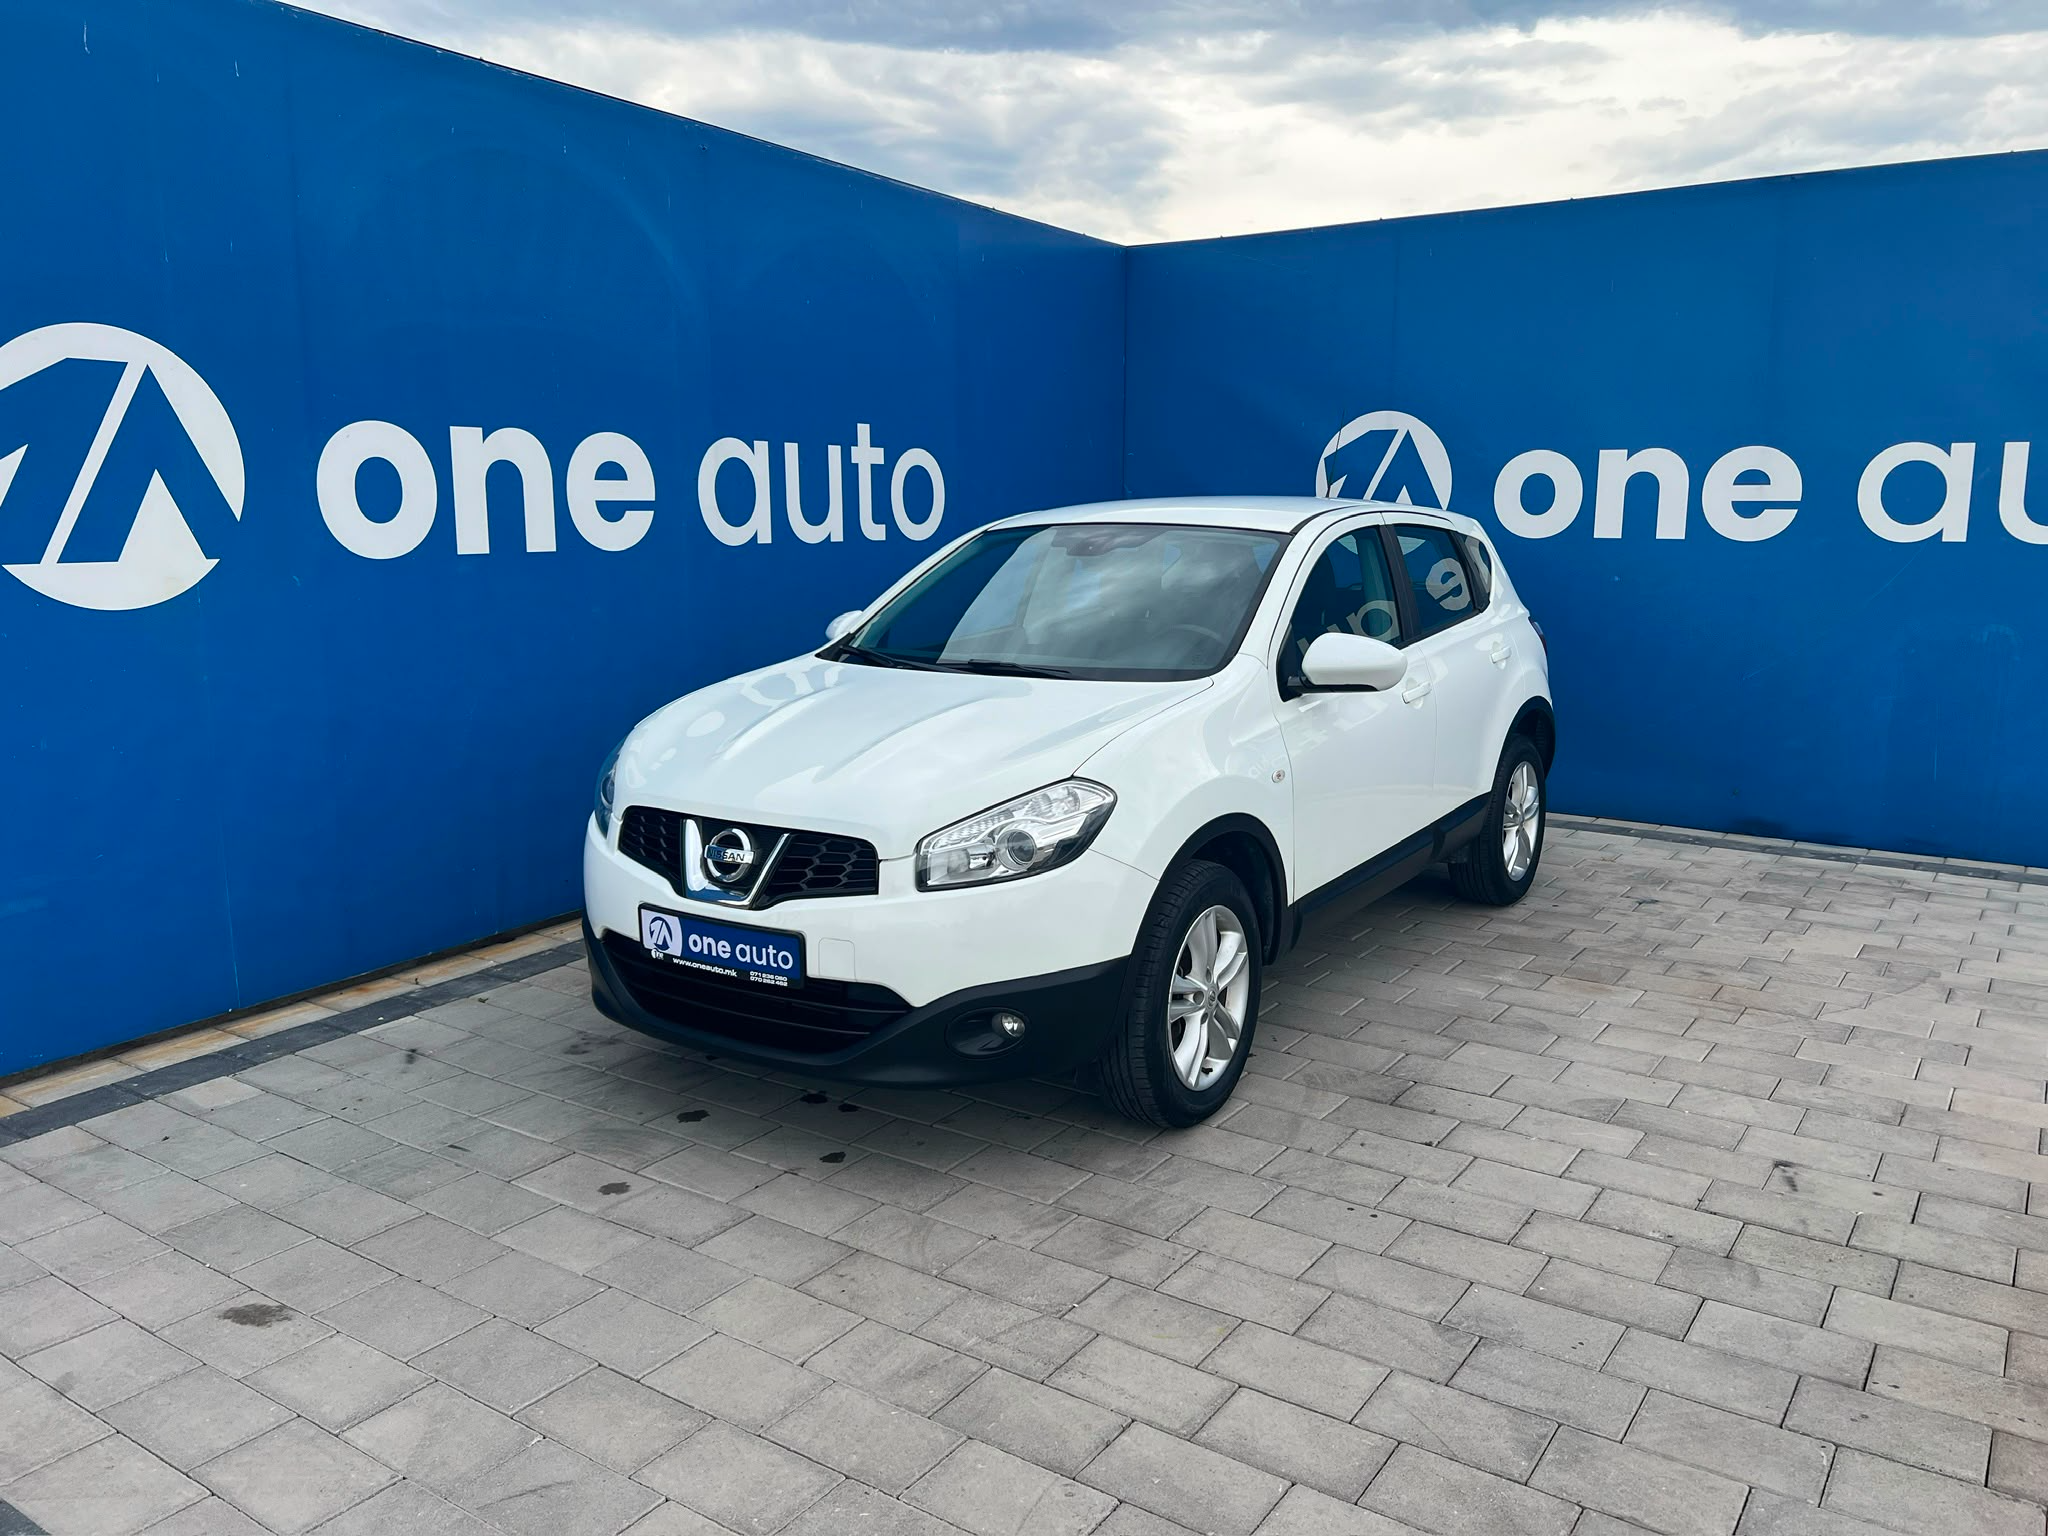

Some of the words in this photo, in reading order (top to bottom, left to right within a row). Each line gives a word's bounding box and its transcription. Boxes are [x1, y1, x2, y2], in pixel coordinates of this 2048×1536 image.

[316, 420, 656, 560] one
[697, 423, 945, 547] auto
[1493, 445, 1803, 542] one
[708, 848, 746, 862] NISSAN
[672, 956, 738, 978] www.oneauto.mk
[688, 933, 732, 959] one
[735, 943, 794, 970] auto
